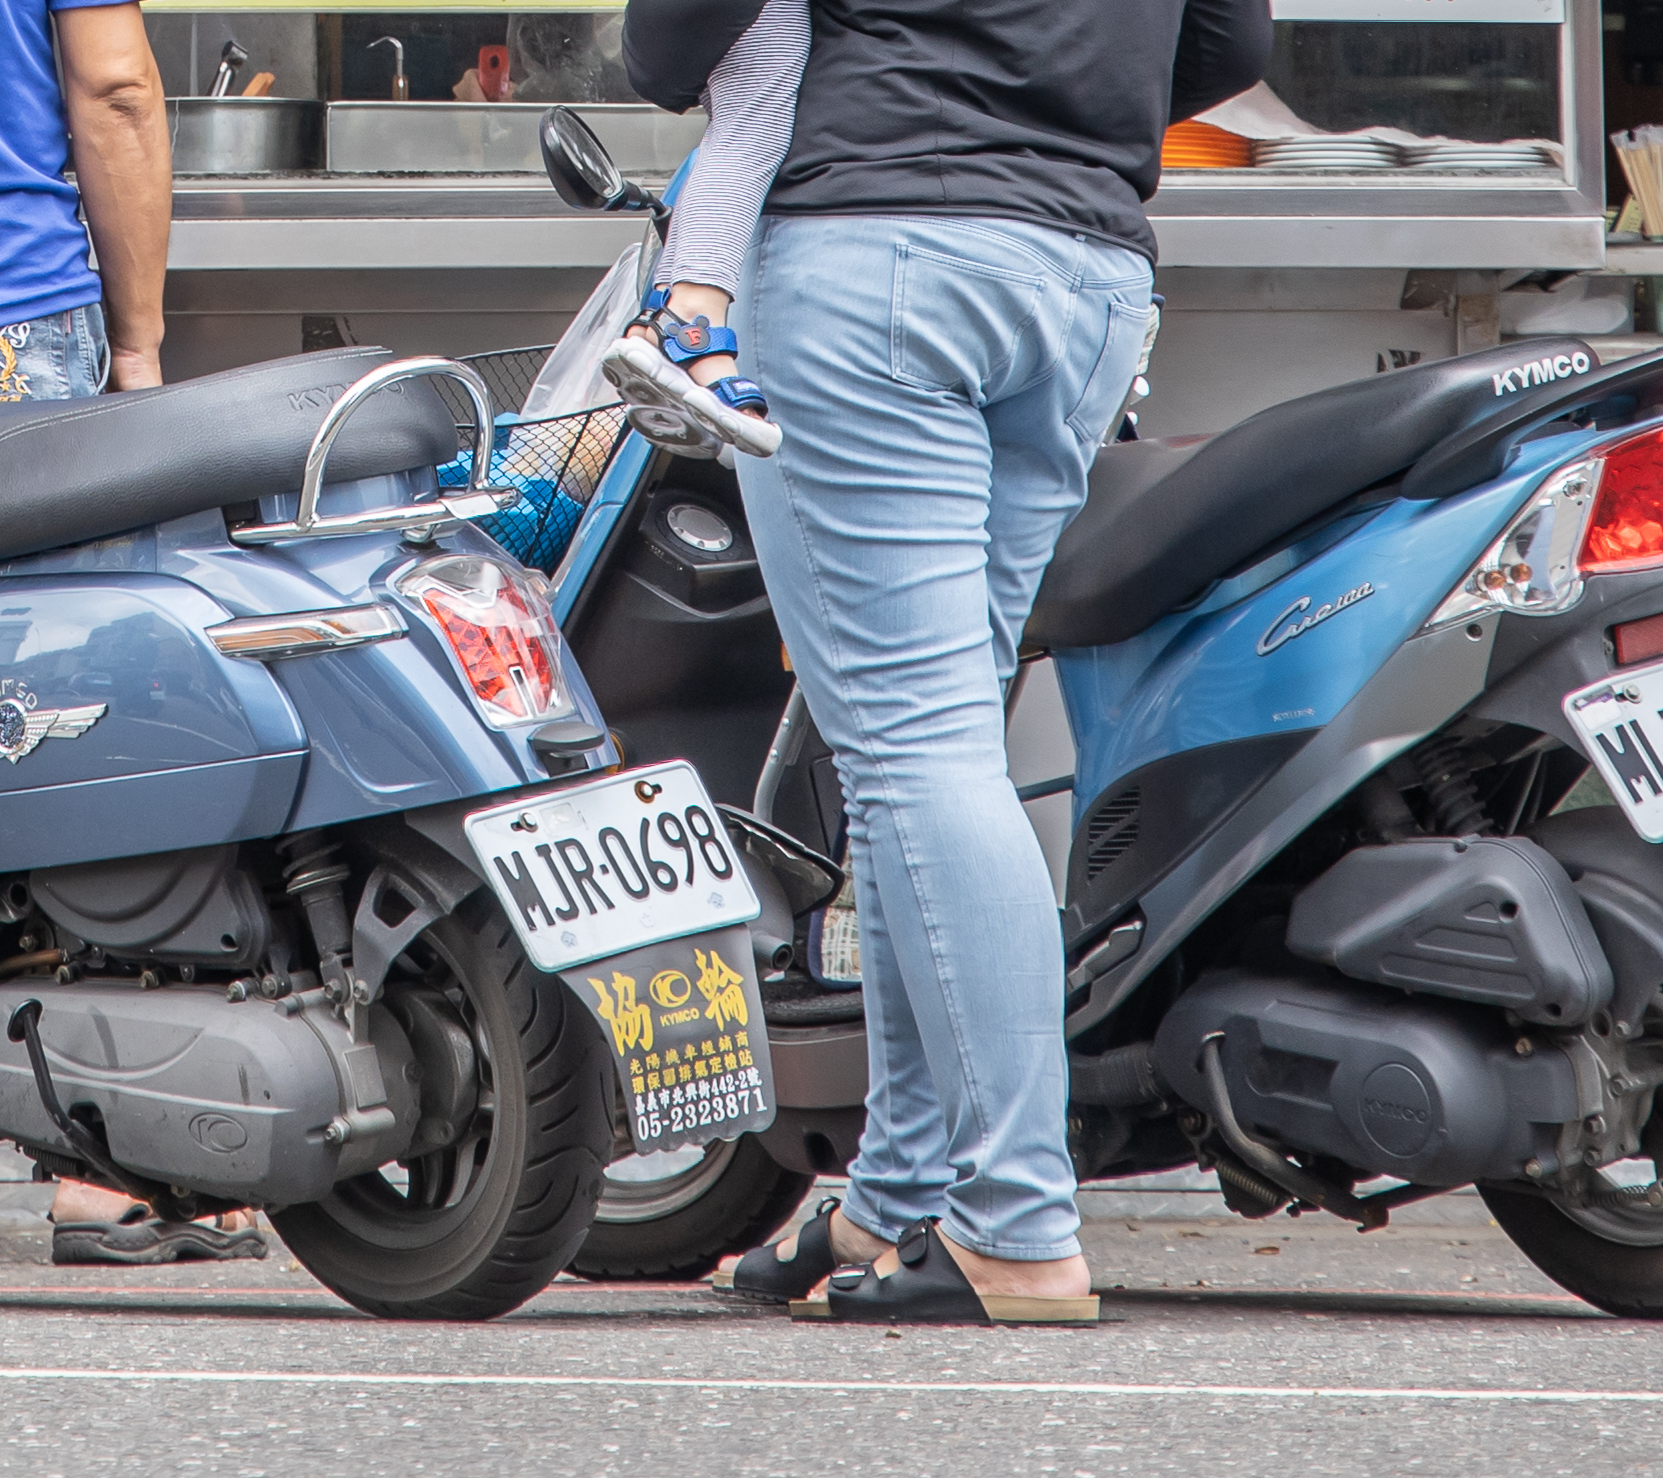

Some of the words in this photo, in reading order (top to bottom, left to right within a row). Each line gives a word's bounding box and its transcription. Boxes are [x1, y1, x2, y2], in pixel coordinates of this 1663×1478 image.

[1492, 351, 1591, 397] KYMCO
[660, 1007, 700, 1027] KYMCO
[637, 1087, 768, 1141] 05-2323871
